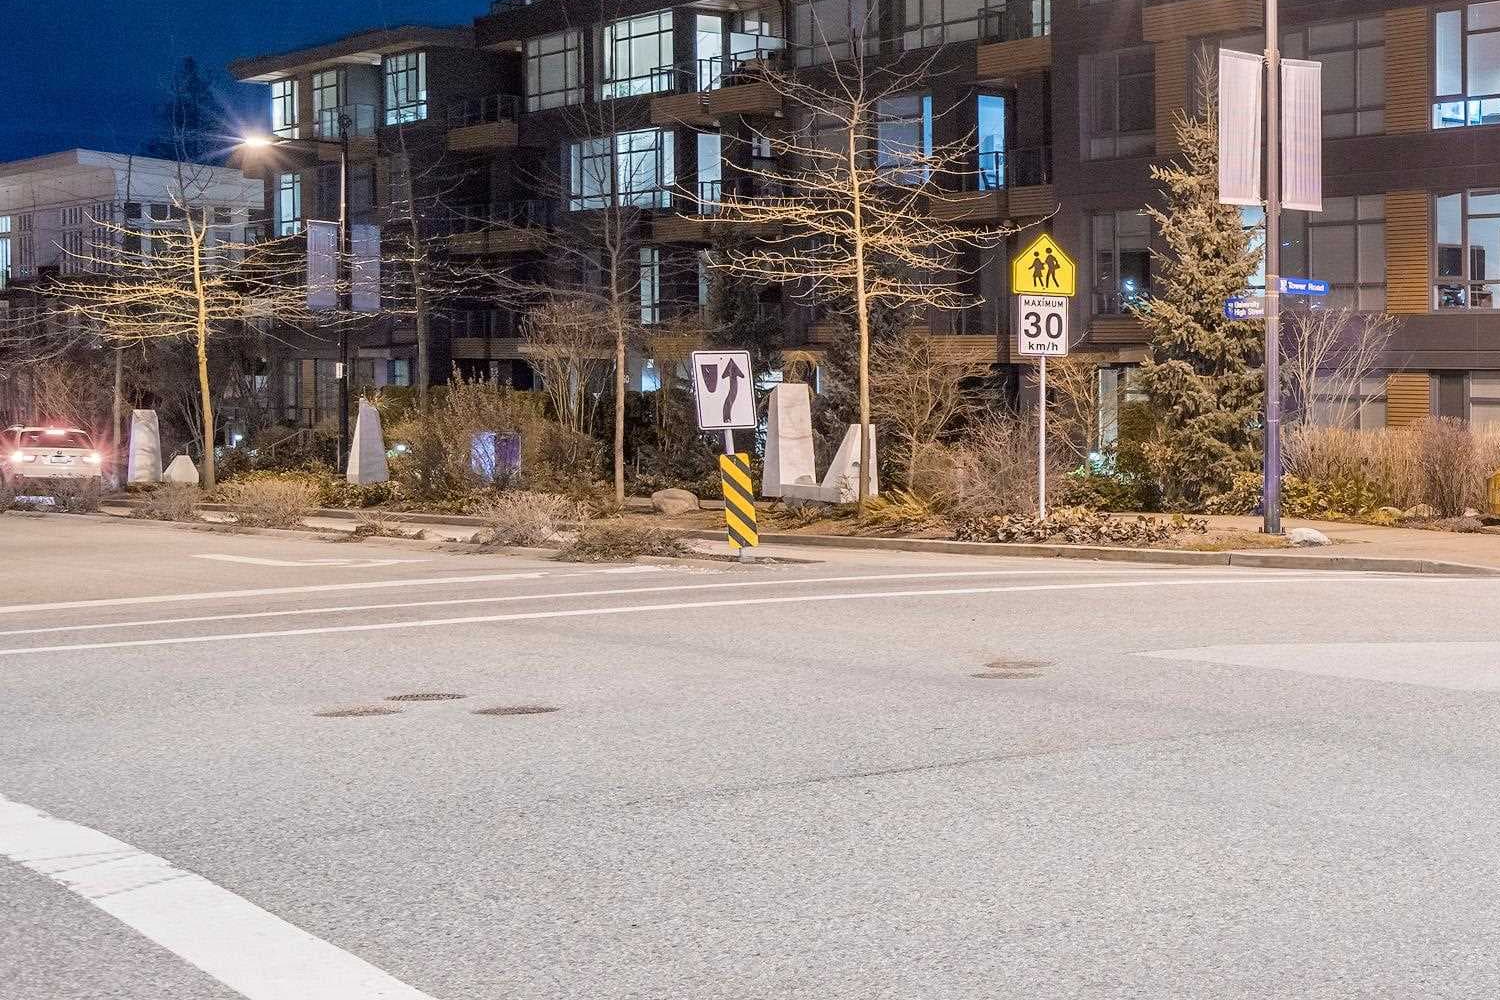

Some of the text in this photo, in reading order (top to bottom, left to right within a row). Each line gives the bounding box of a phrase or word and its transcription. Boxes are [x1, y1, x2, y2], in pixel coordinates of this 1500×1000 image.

[1288, 281, 1324, 291] Tower Road
[1024, 299, 1064, 307] MAXIMUM
[1234, 308, 1246, 317] High
[1024, 311, 1063, 339] 30
[1028, 341, 1058, 351] km/h
